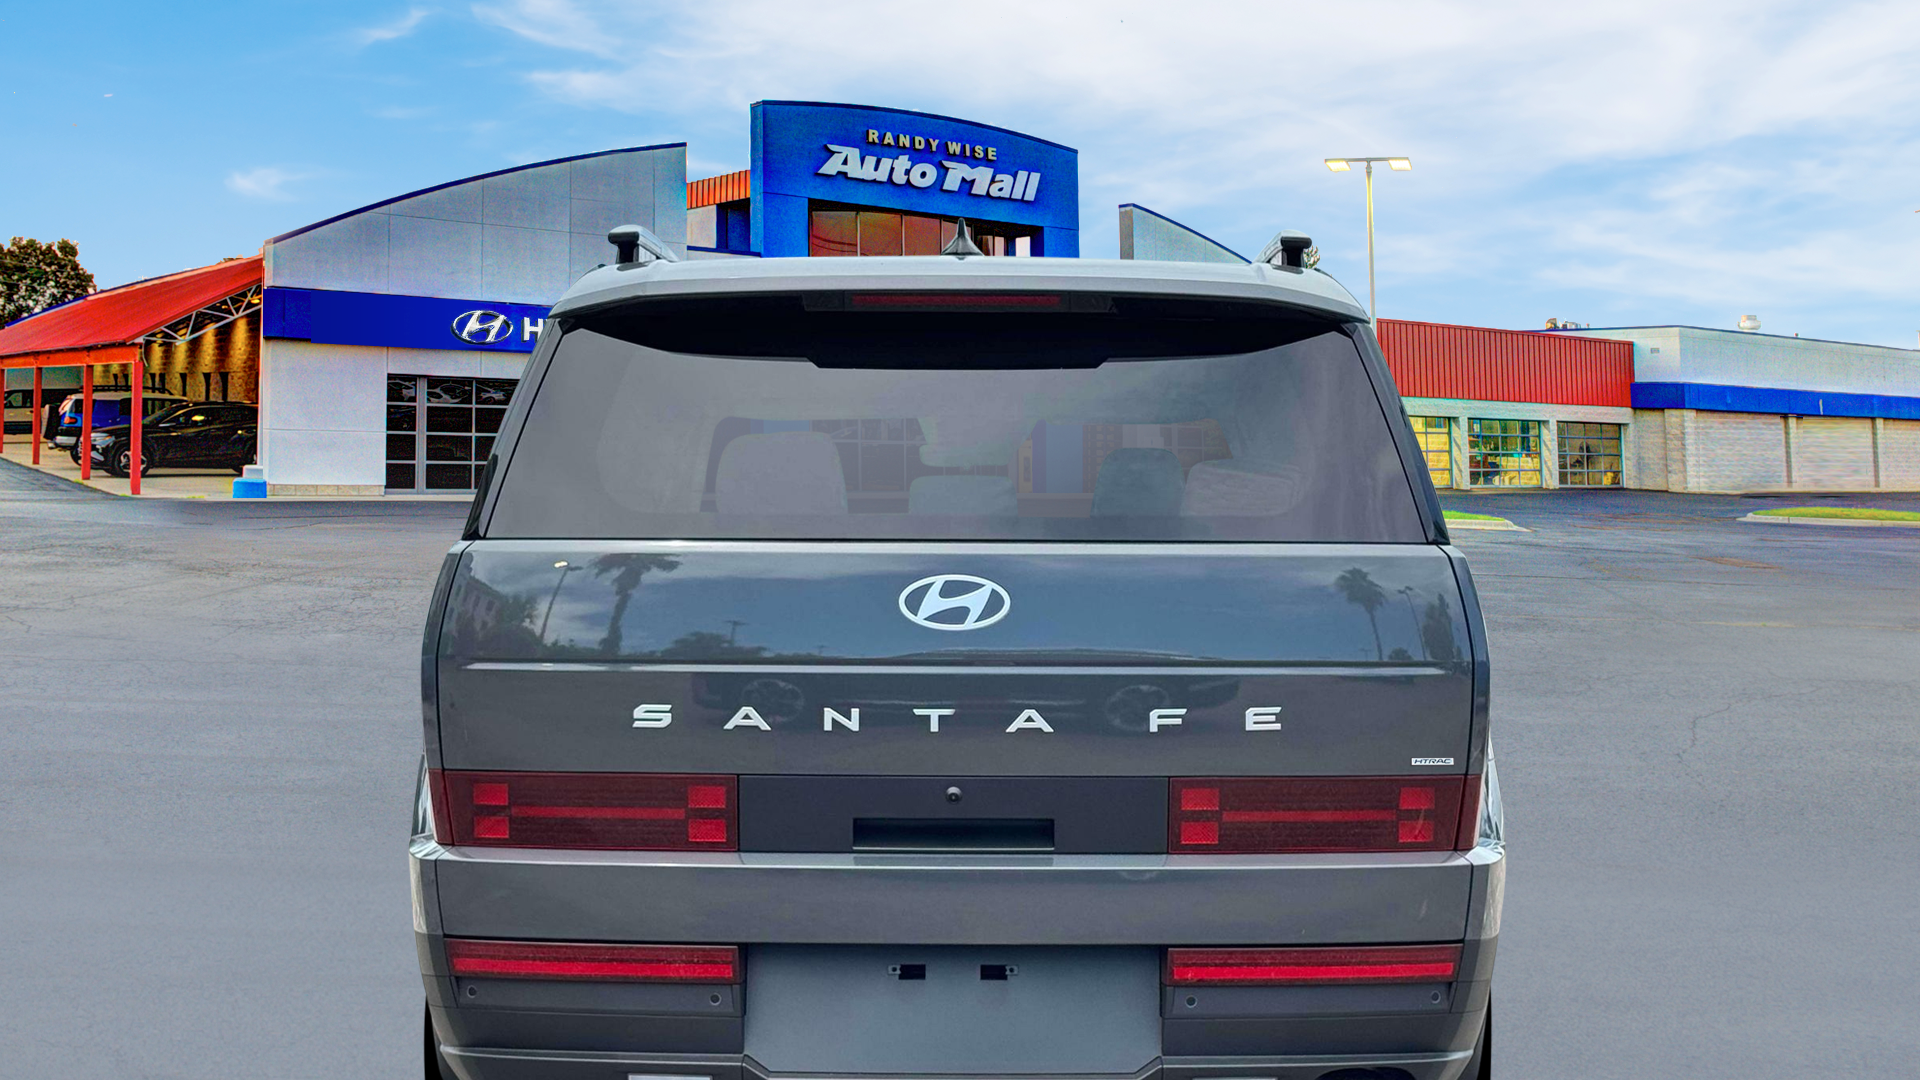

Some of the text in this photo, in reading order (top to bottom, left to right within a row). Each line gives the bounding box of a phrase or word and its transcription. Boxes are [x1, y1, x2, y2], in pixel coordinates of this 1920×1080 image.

[867, 129, 997, 160] RANDY WISE
[817, 144, 1041, 201] Auto Mall
[632, 704, 1282, 733] SANTA FE
